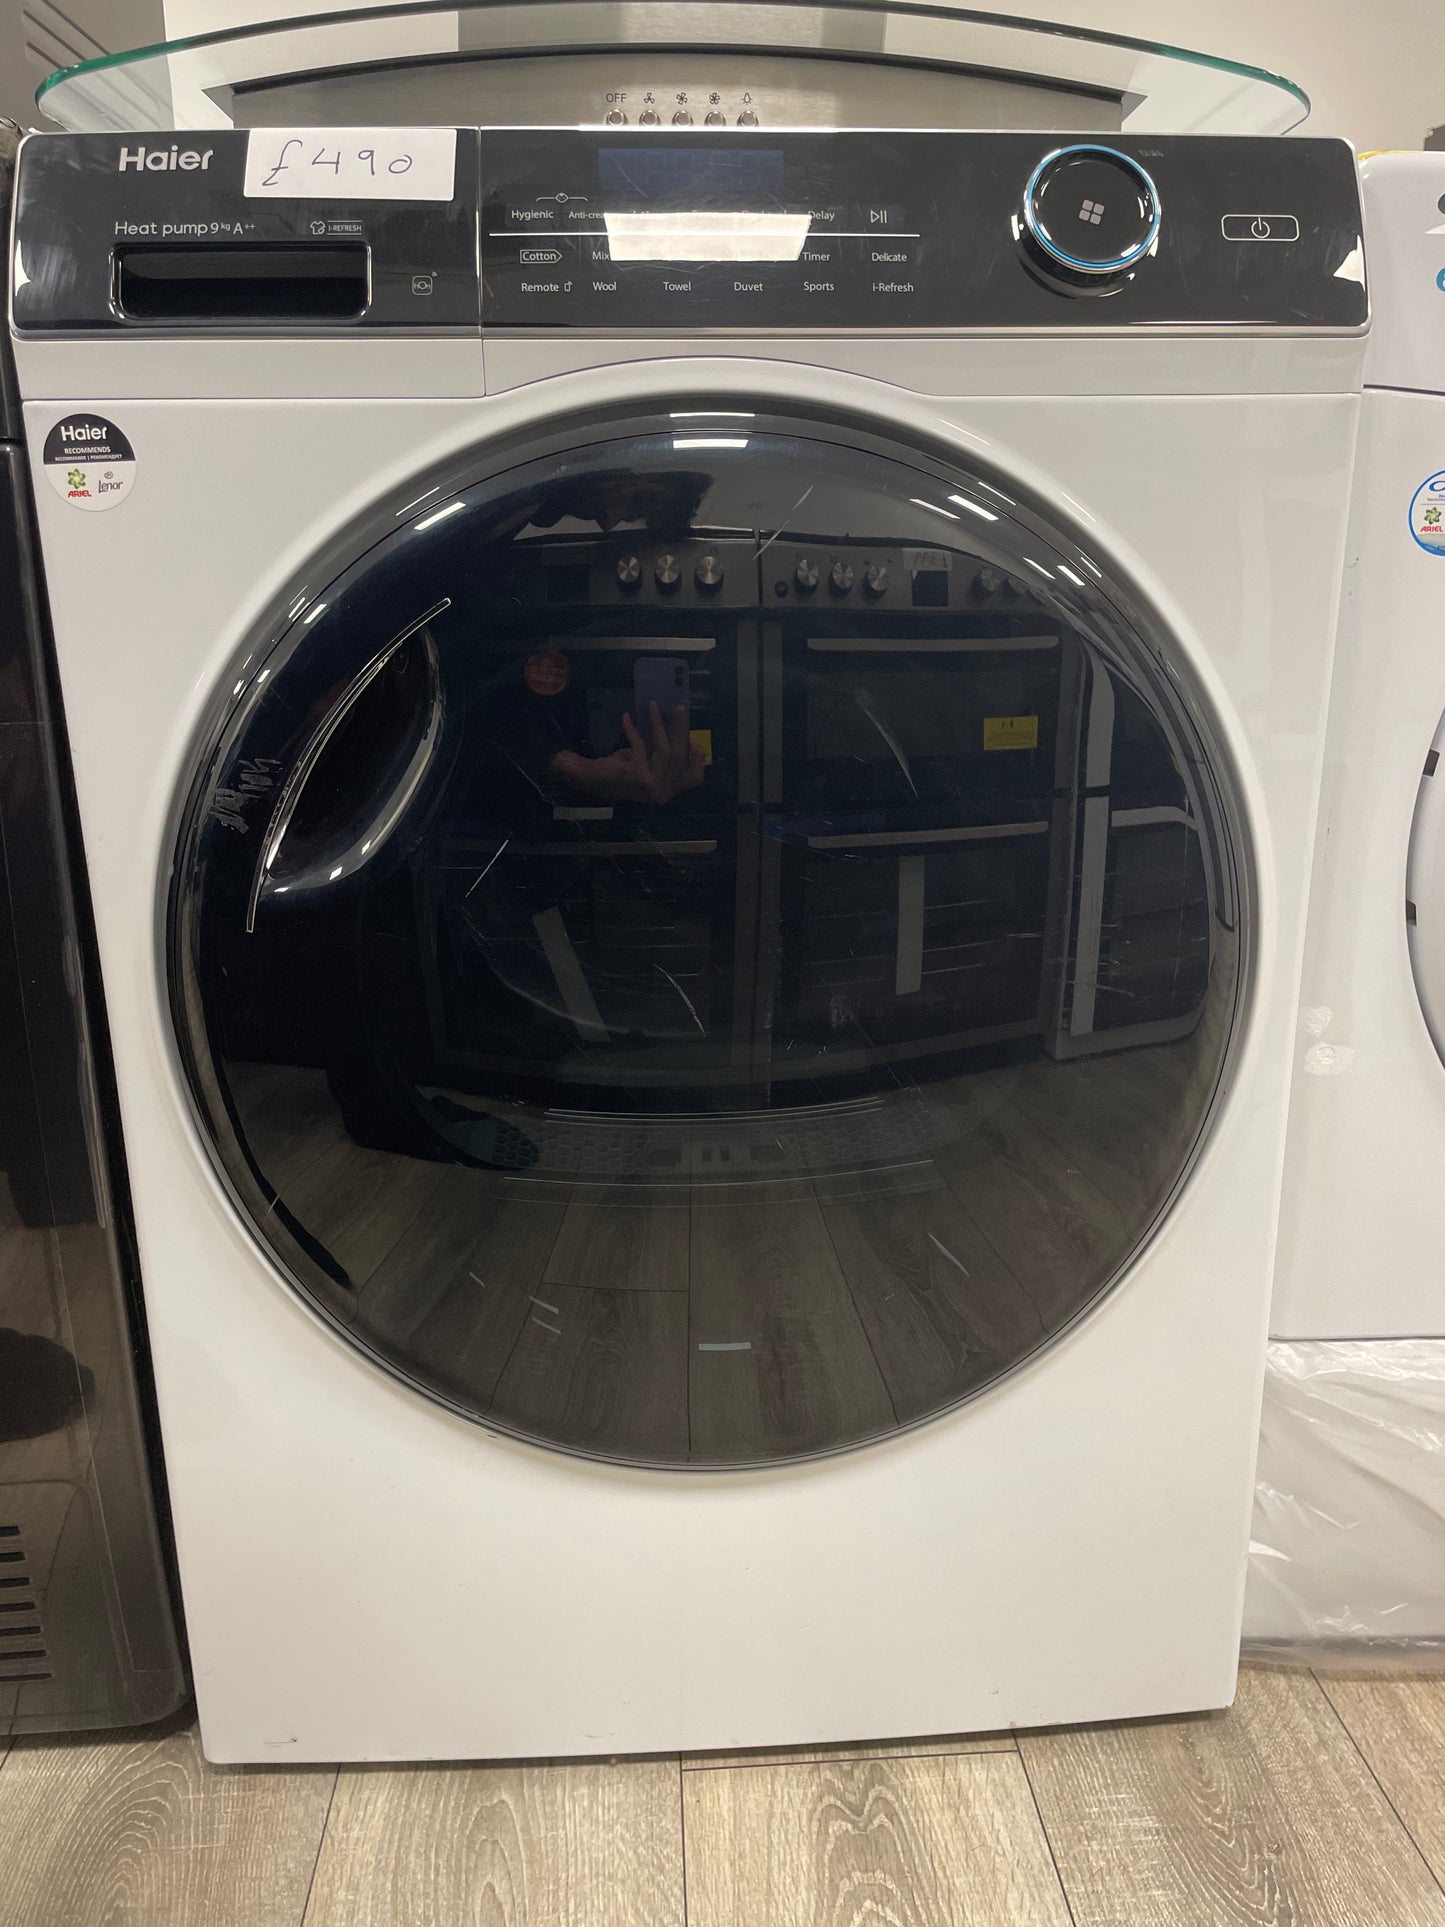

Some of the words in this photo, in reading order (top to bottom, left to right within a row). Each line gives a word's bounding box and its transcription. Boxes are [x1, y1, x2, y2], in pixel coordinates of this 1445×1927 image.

[606, 92, 627, 103] OFF
[118, 144, 214, 172] Haier
[511, 209, 554, 221] Hygienic
[807, 210, 835, 222] Delay
[114, 221, 158, 235] Heat
[162, 222, 208, 237] pump
[522, 251, 557, 262] Cotton
[592, 251, 610, 260] Mix
[802, 252, 831, 262] Timer
[871, 252, 908, 262] Delicate
[521, 282, 560, 292] Remote
[592, 281, 617, 291] Wool
[663, 281, 692, 291] Towel
[733, 281, 764, 292] Duvet
[803, 281, 835, 293] Sports
[872, 282, 914, 292] i-Refresh
[60, 424, 108, 442] Haier
[64, 446, 111, 454] RECOMMENDS
[98, 480, 124, 493] Lenor
